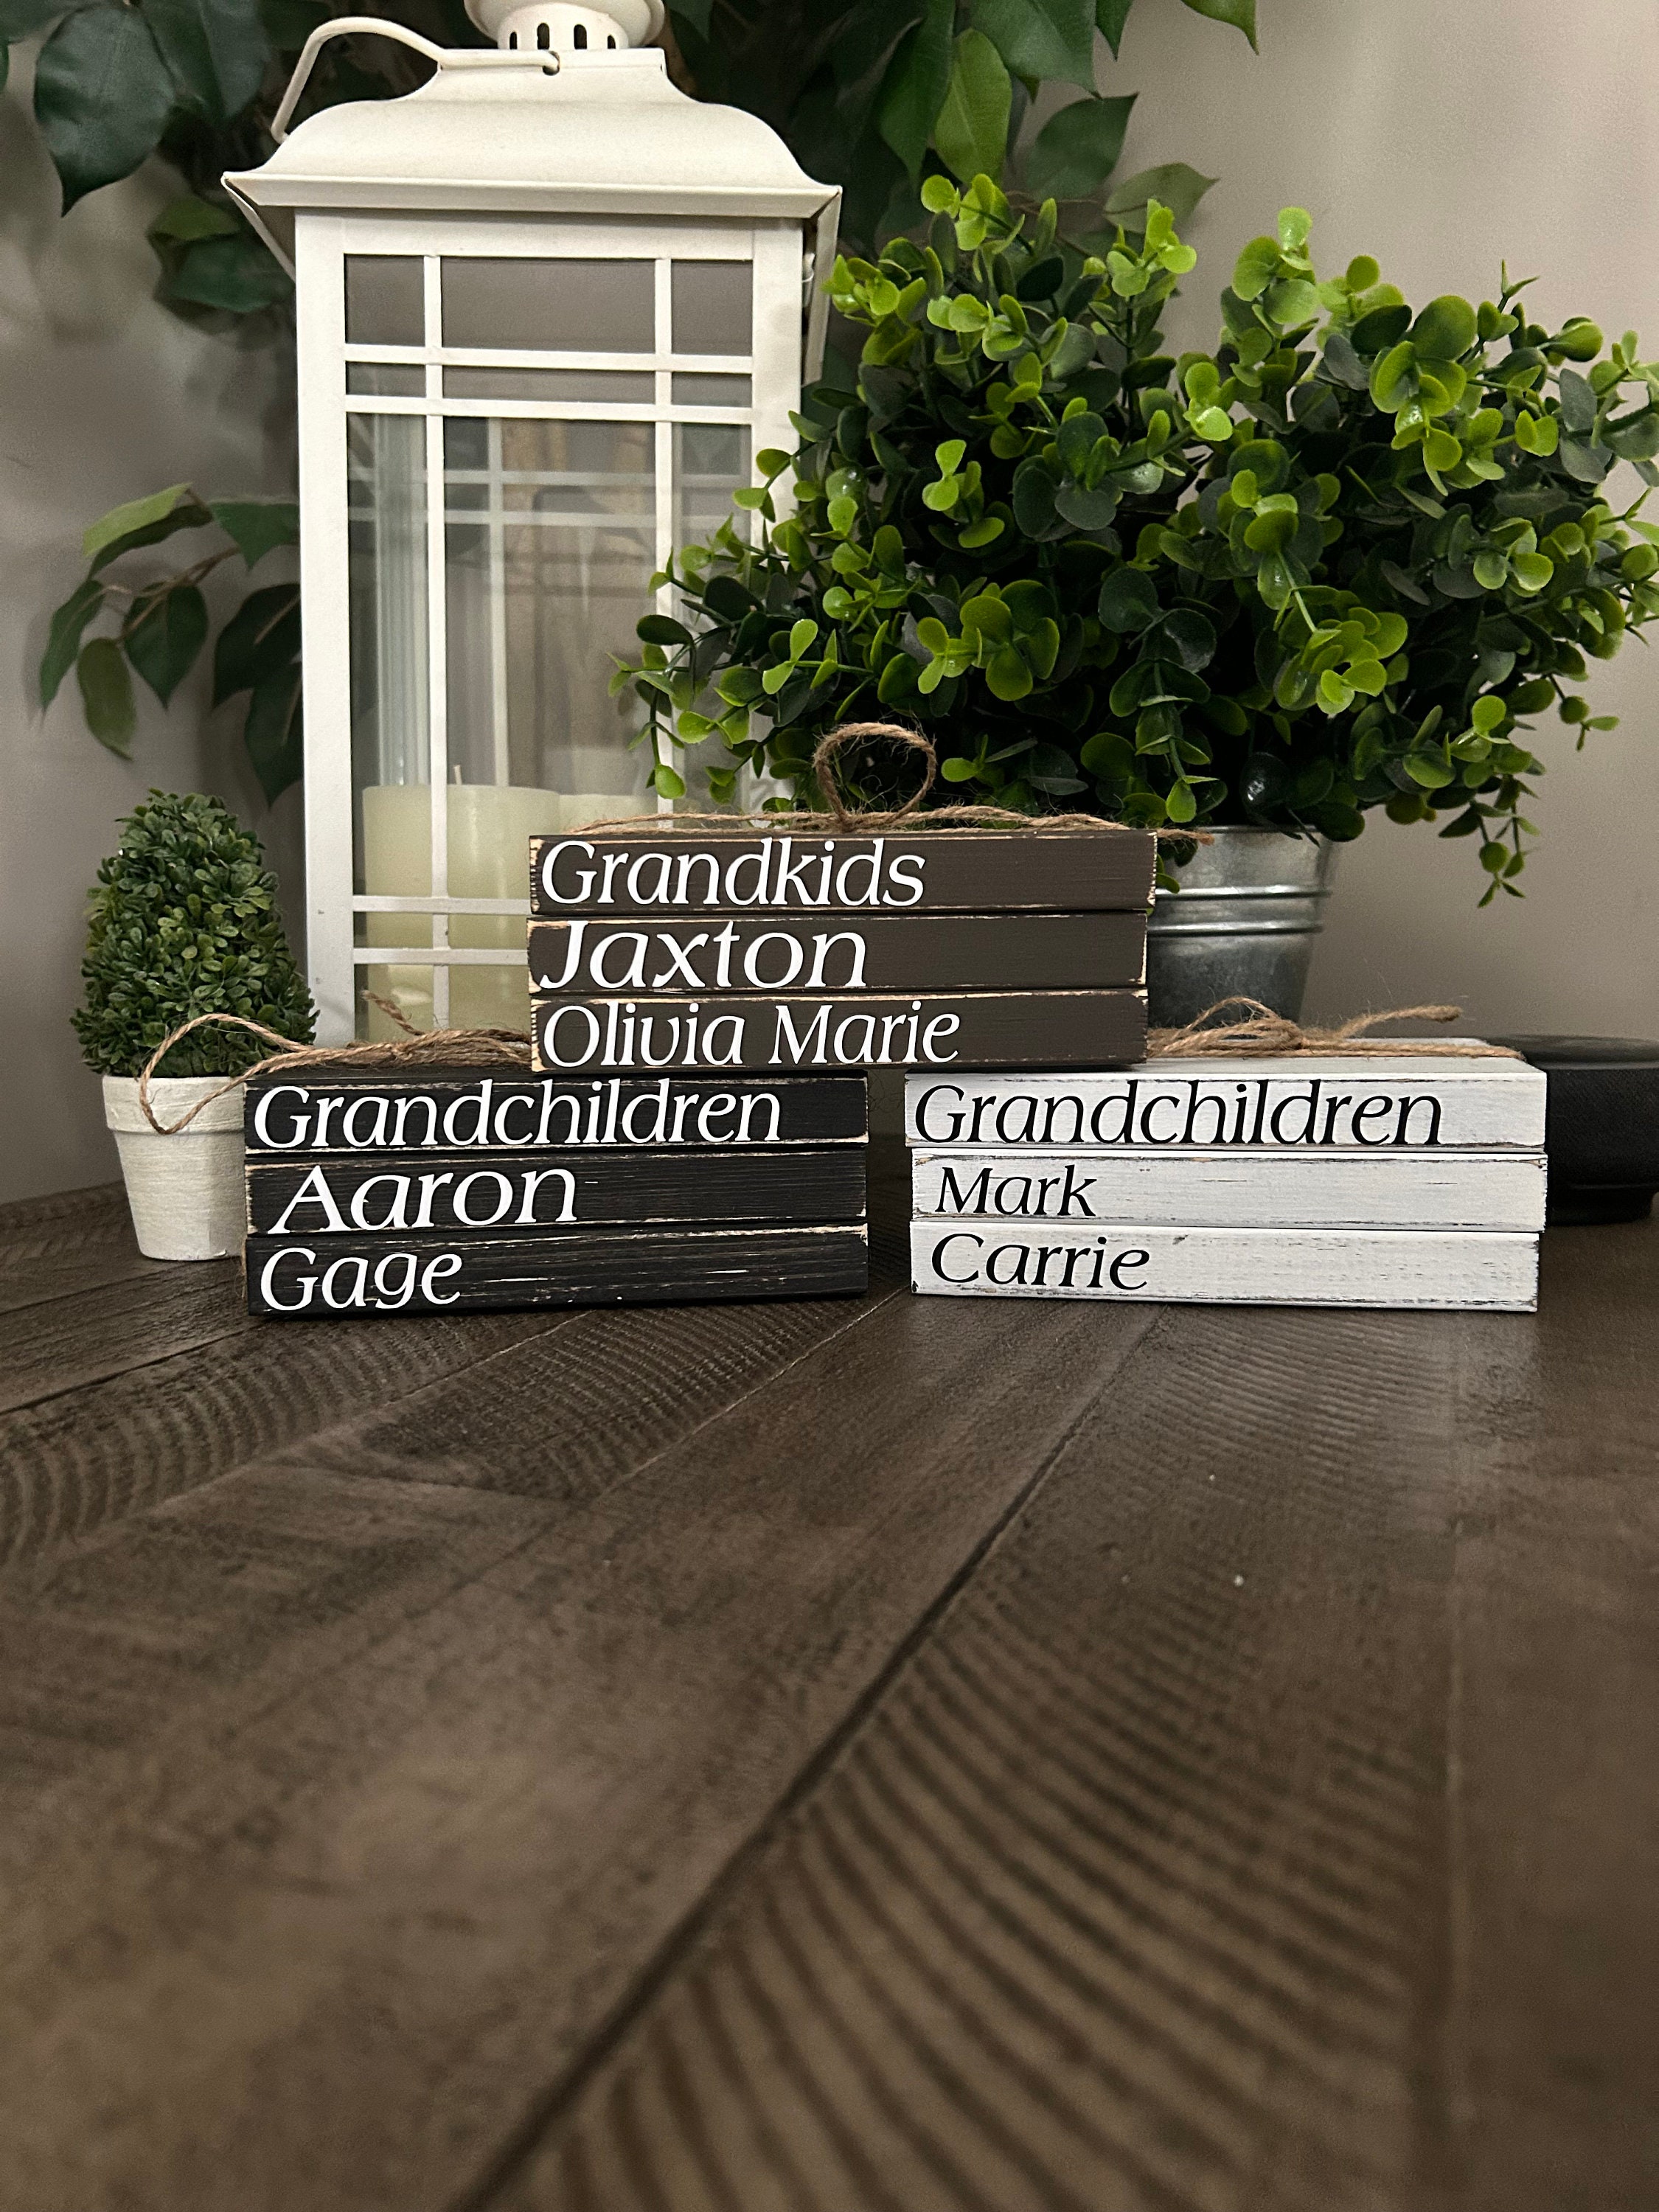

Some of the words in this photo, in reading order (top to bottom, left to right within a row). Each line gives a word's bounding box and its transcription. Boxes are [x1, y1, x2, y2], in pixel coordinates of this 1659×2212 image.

[541, 837, 926, 906] Grandkids
[539, 919, 867, 990] Jaxton
[543, 1001, 746, 1068] Olivia
[768, 1000, 961, 1065] Marie
[254, 1077, 782, 1150] Grandchildren
[914, 1078, 1442, 1146] Grandchildren
[267, 1164, 578, 1235] Aaron
[934, 1164, 1098, 1217] Mark
[260, 1247, 462, 1311] Gage
[931, 1232, 1150, 1291] Carrie
